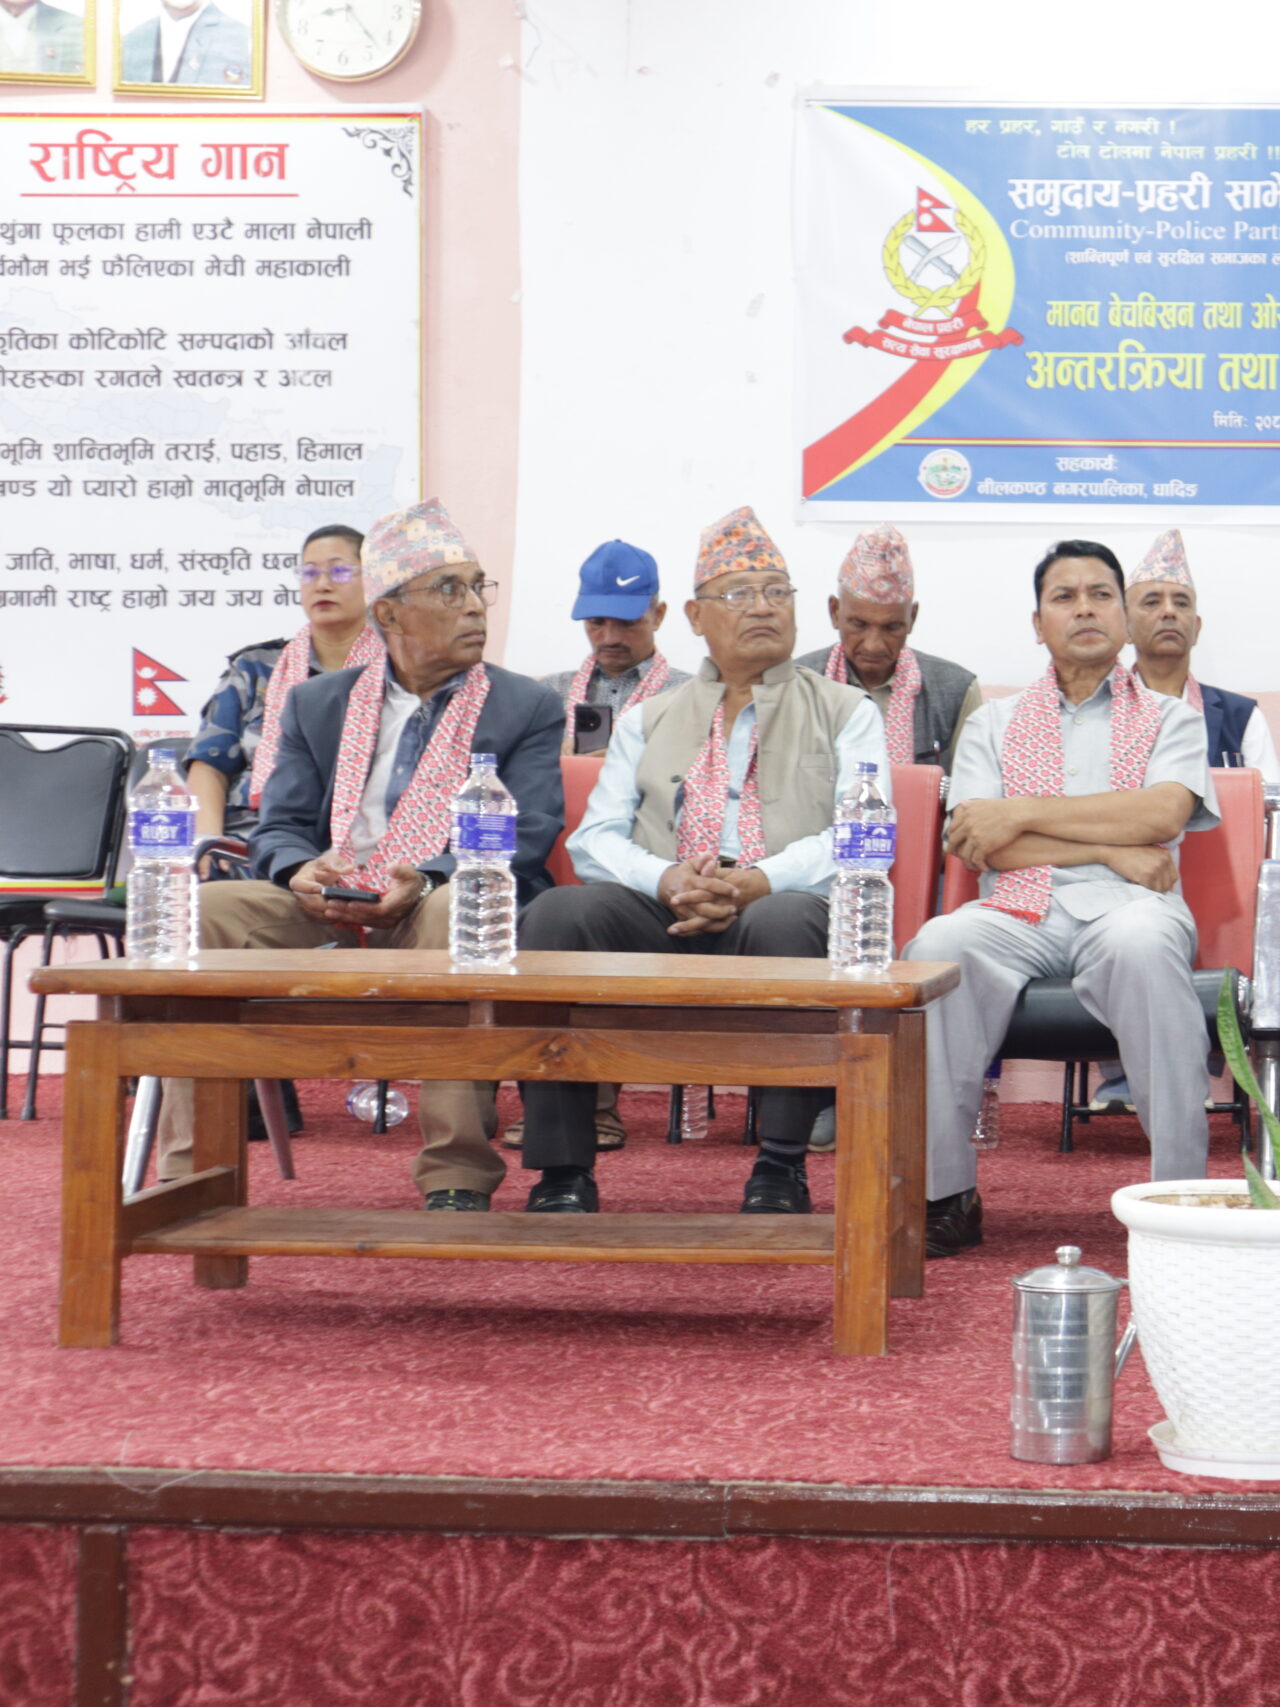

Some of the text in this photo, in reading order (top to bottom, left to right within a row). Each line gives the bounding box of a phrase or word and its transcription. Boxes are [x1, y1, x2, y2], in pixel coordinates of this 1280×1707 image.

[965, 120, 990, 134] हर
[1093, 121, 1104, 135] र
[1114, 118, 1160, 136] नगरी
[29, 128, 290, 192] राष्ट्रिय गान
[1057, 141, 1090, 159] टोल
[1099, 141, 1152, 159] टोलमा
[1160, 141, 1205, 160] नेपाल
[1213, 142, 1258, 161] प्रहरी
[1007, 171, 1213, 217] समुदाय-प्रहरी
[53, 223, 125, 247] फूलका
[136, 218, 182, 242] हामी
[193, 218, 235, 242] एउटै
[245, 222, 296, 241] माला
[307, 218, 373, 242] नेपाली
[1009, 219, 1226, 245] Community-Police
[60, 255, 91, 280] भई
[103, 253, 195, 278] फैलिएका
[205, 254, 246, 277] मेची
[256, 254, 351, 279] महाकाली
[1046, 299, 1101, 328] मानव
[1108, 293, 1195, 330] बेचबिखन
[1203, 301, 1243, 330] तथा
[68, 327, 168, 351] कोटिकोटि
[178, 328, 275, 351] सम्पदाको
[95, 364, 164, 389] रगतले
[173, 369, 245, 389] स्वतन्त्र
[254, 369, 269, 389] र
[279, 369, 333, 389] अटल
[1025, 338, 1206, 392] अन्तरक्रिया
[1218, 352, 1280, 392] तथा
[54, 437, 154, 466] शान्तिभूमि
[165, 437, 221, 464] तराई,
[230, 441, 287, 464] पहाड,
[297, 437, 364, 462] हिमाल
[48, 474, 73, 497] यो
[83, 474, 138, 499] प्यारो
[147, 474, 195, 500] हाम्रो
[204, 474, 287, 503] मातृभूमि
[296, 474, 356, 498] नेपाल
[6, 547, 59, 573] जाति,
[69, 552, 121, 573] भाषा,
[130, 547, 169, 573] धर्म,
[178, 547, 253, 576] संस्कृति
[68, 589, 113, 612] राष्ट्र
[122, 584, 169, 610] हाम्रो
[179, 589, 217, 608] जय
[226, 589, 264, 608] जय
[140, 825, 179, 840] RUBY
